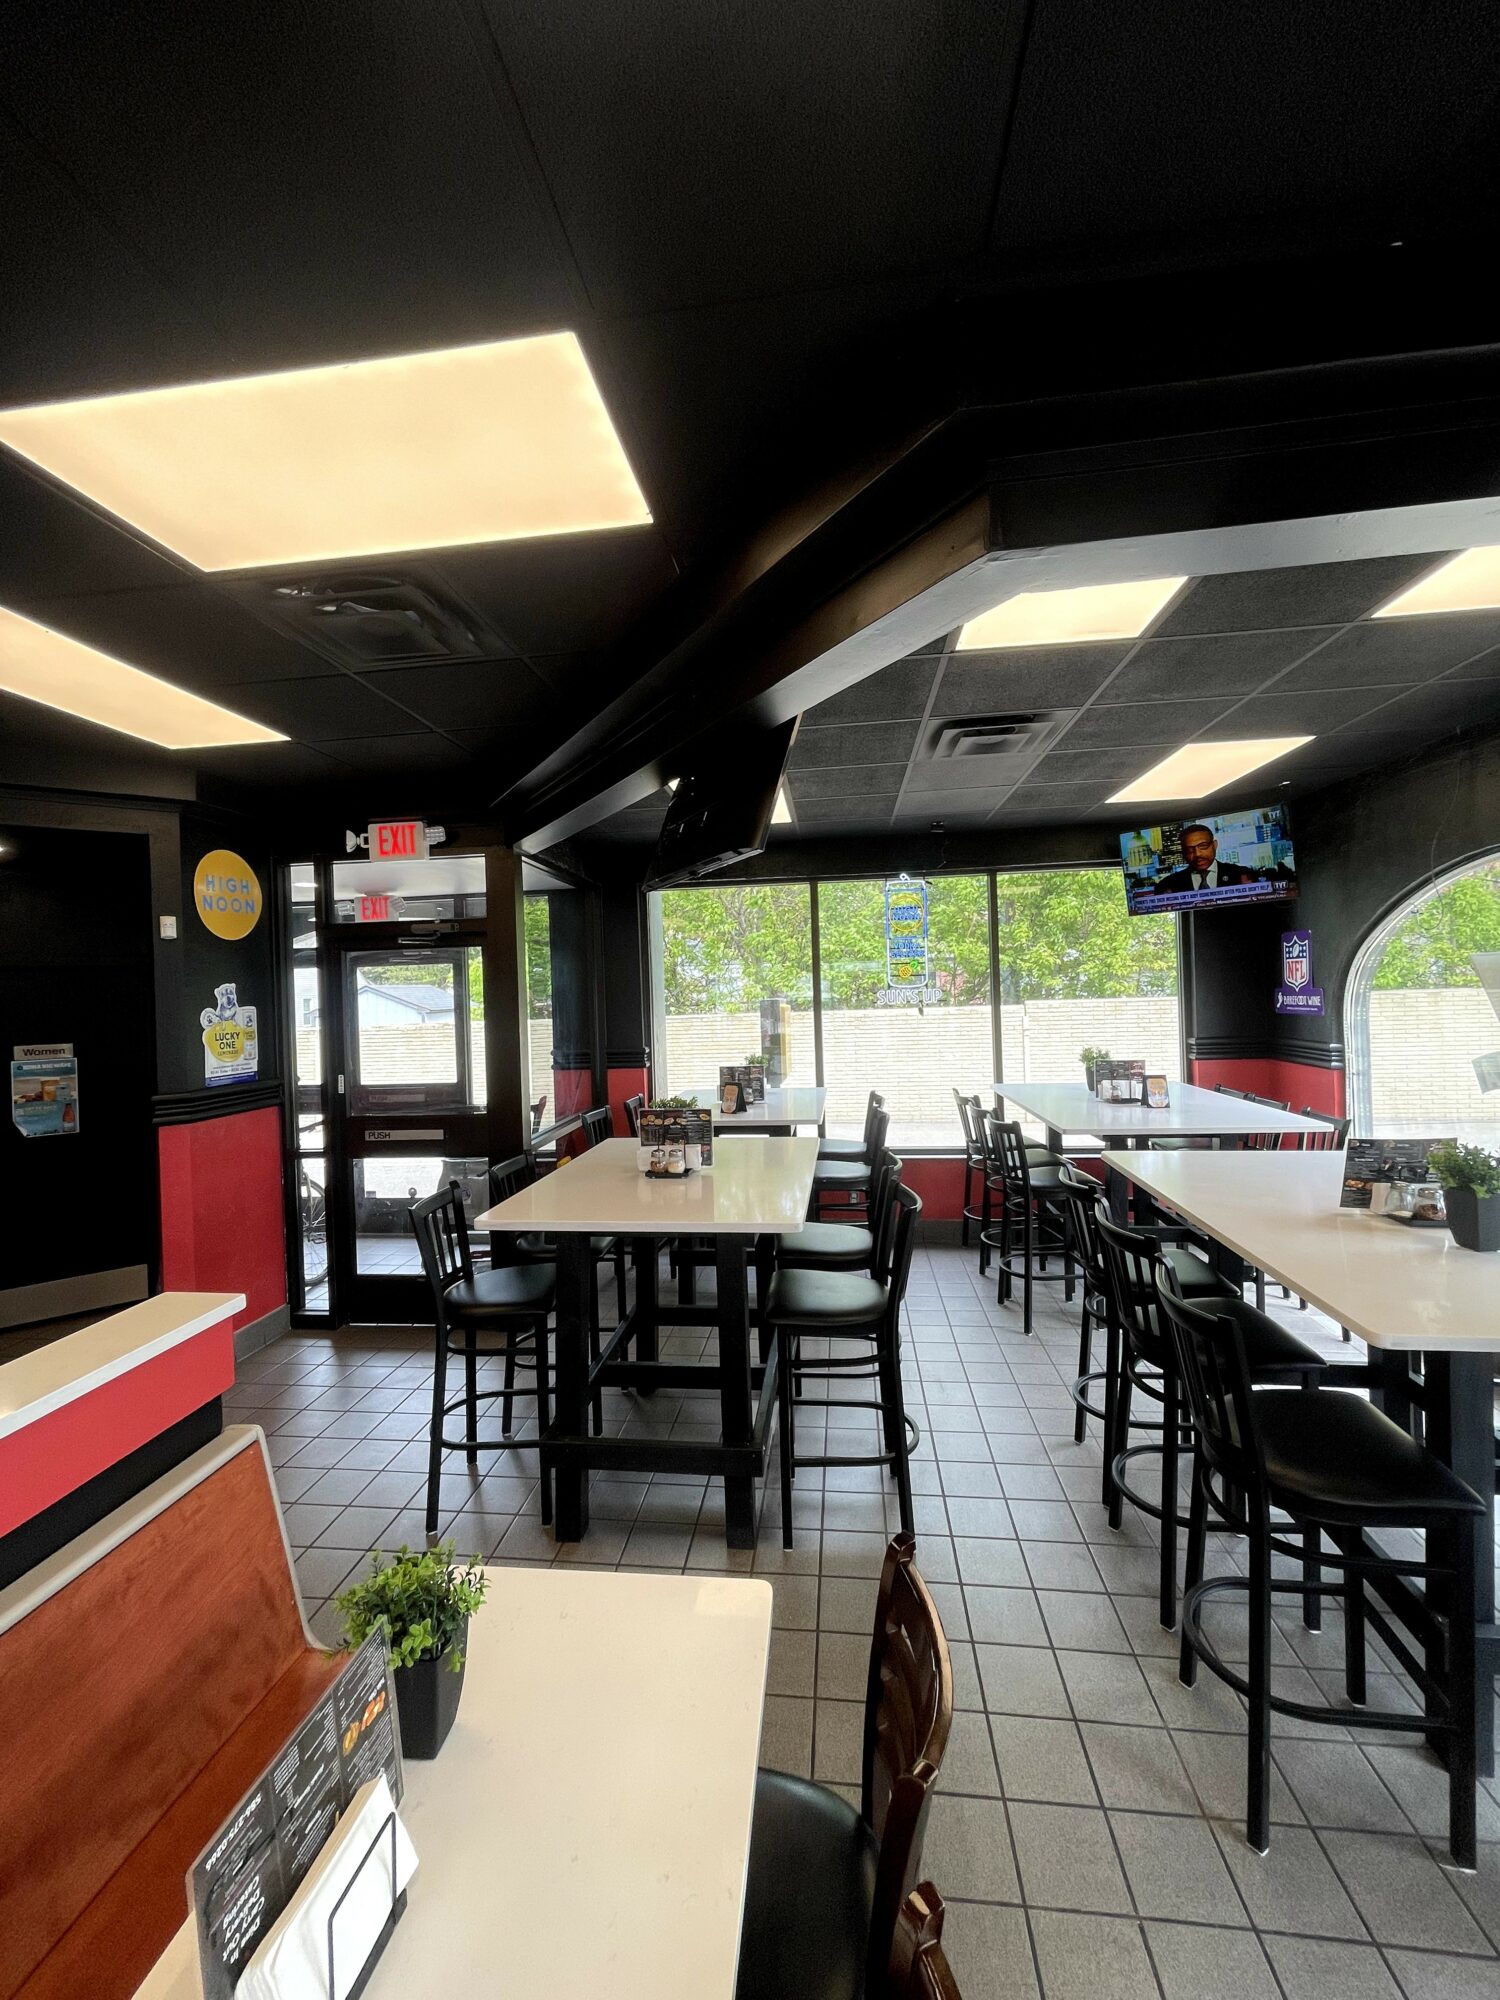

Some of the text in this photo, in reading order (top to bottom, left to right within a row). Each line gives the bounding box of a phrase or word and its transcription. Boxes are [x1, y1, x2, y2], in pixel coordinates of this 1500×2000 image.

[378, 823, 417, 856] EXIT
[205, 873, 251, 893] HIGH
[1275, 881, 1287, 889] TYT
[202, 896, 256, 914] NOON
[362, 895, 390, 920] EXIT
[1287, 960, 1306, 981] NFL
[877, 988, 943, 1005] SUN'S UP
[1284, 995, 1321, 1005] BAREFOOT WINE
[215, 1032, 240, 1041] LUCKY
[219, 1041, 236, 1050] ONE
[23, 1048, 66, 1056] Women
[206, 1792, 261, 1872] 586-275-0266
[223, 1873, 259, 1930] Catering
[224, 1886, 259, 1943] Delivery
[241, 1895, 265, 1934] Carry
[240, 1915, 260, 1948] Dine
[222, 1932, 240, 1962] Out
